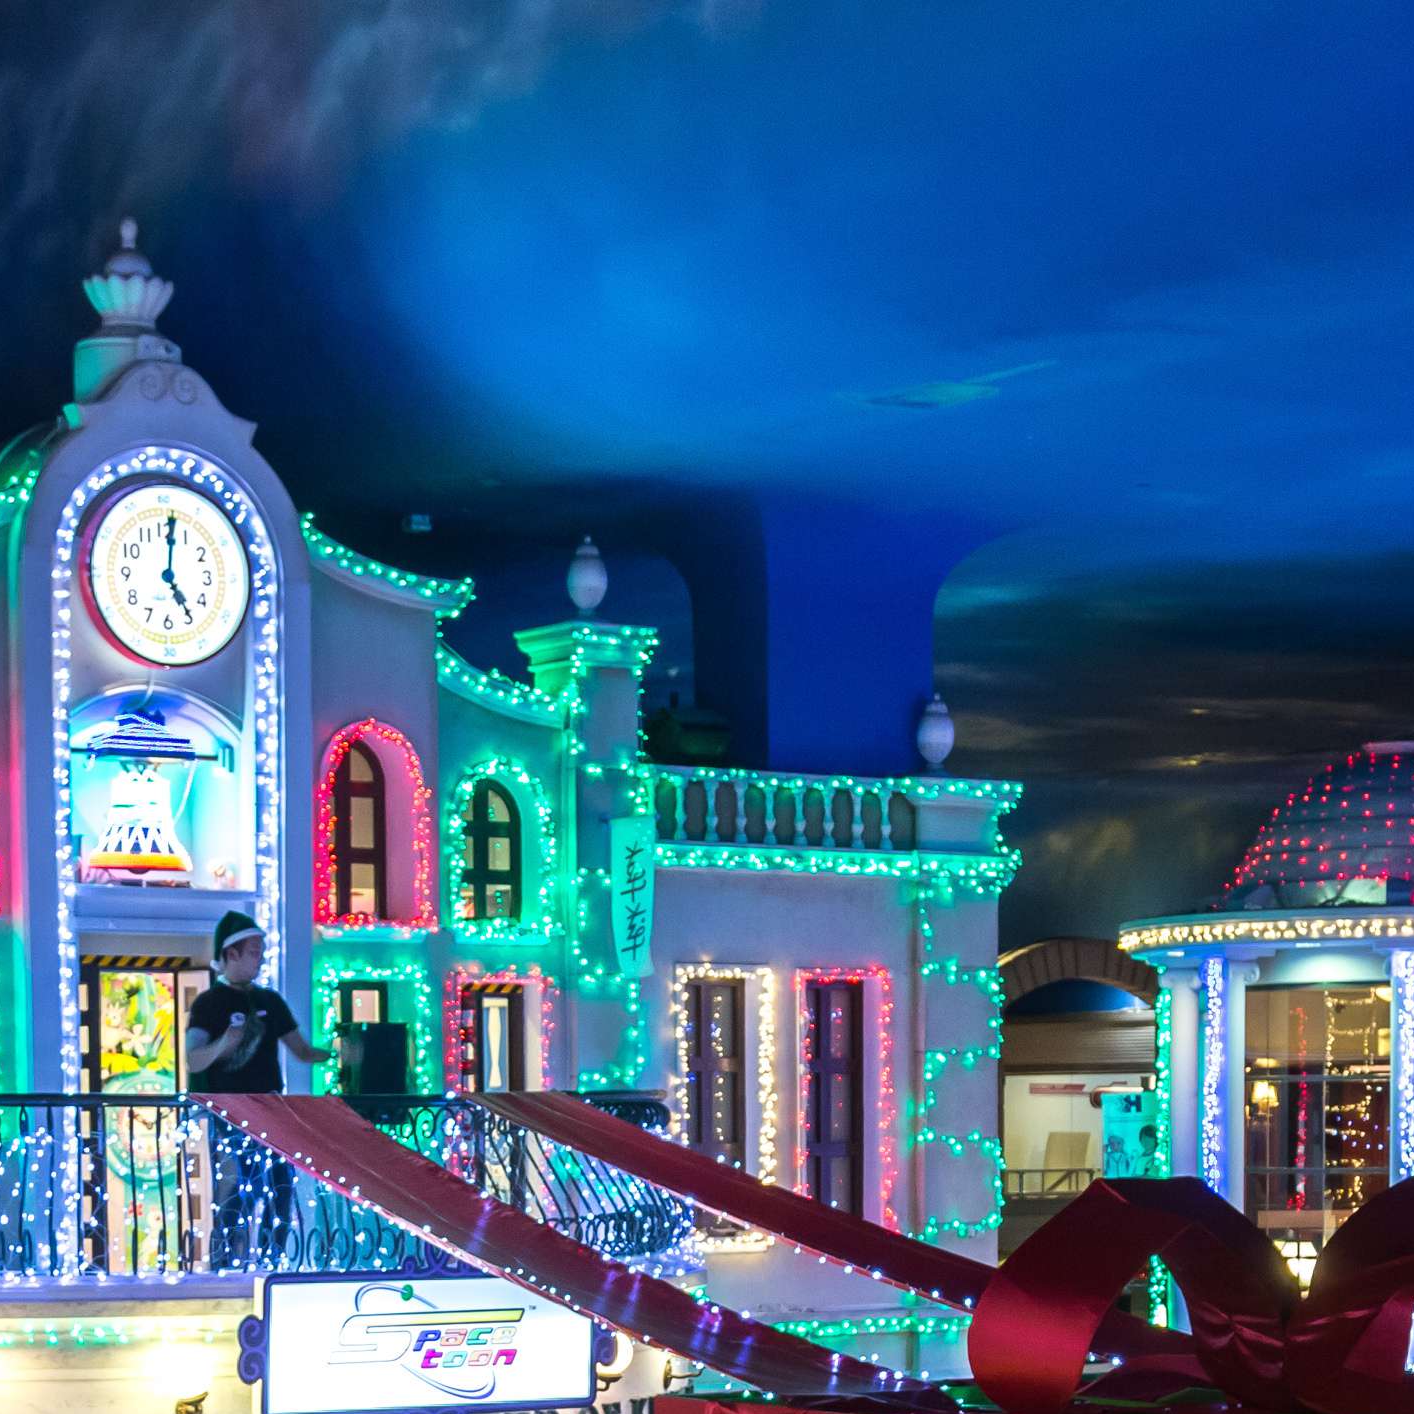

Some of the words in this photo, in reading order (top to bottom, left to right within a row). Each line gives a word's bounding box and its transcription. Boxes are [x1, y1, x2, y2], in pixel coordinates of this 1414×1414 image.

[139, 527, 152, 543] 11
[123, 543, 141, 560] 10
[196, 546, 206, 562] 2
[120, 566, 131, 581] 9
[202, 570, 212, 586] 3
[127, 589, 138, 605] 8
[196, 593, 207, 608] 4
[144, 607, 154, 623] 7
[163, 614, 174, 630] 6
